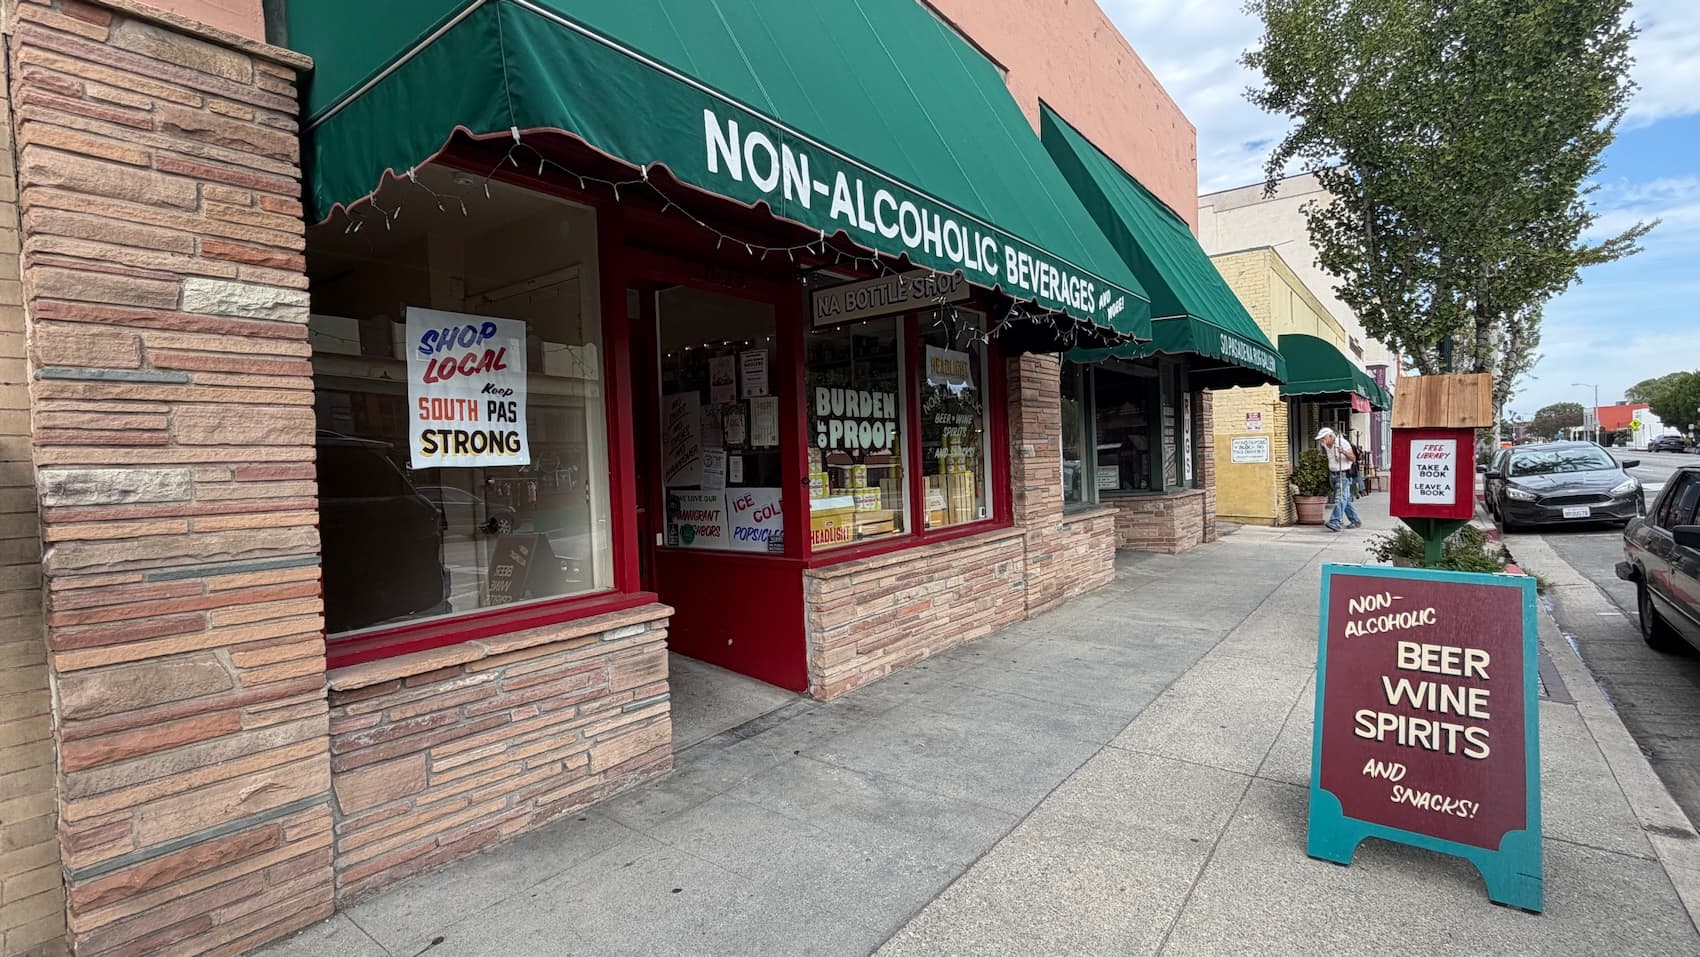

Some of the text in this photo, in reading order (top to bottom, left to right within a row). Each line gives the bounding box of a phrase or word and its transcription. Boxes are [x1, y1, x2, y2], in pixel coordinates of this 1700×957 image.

[704, 108, 1095, 314] NON-ALCOHOLIC BEVERAGES
[817, 271, 964, 318] NA BOTTLE SHOP
[1098, 289, 1112, 311] AND
[1107, 296, 1125, 322] MORE!
[418, 321, 498, 355] SHOP
[1228, 336, 1254, 363] PASADENA
[423, 347, 507, 384] LOCAL
[481, 382, 514, 398] Keep
[815, 386, 896, 418] BURDEN
[922, 388, 983, 415] NON-ALOLIC
[418, 397, 517, 423] SOUTH PAS
[934, 412, 973, 425] BEER WINE
[419, 429, 521, 458] STRONG
[816, 419, 897, 449] OF PROOF
[1416, 452, 1450, 460] LIBRARY
[704, 495, 717, 503] OUR
[732, 493, 754, 513] ICE
[680, 524, 721, 538] HBORS
[811, 527, 850, 546] HEADLIGHT
[1348, 591, 1404, 615] NON-
[1344, 607, 1437, 639] ALCOHOLIC
[1397, 640, 1490, 680] BEER
[1381, 676, 1490, 720] WINE
[1354, 709, 1490, 760] SPIRITS
[1362, 758, 1407, 782] AND
[1390, 785, 1480, 819] SNACKS!
